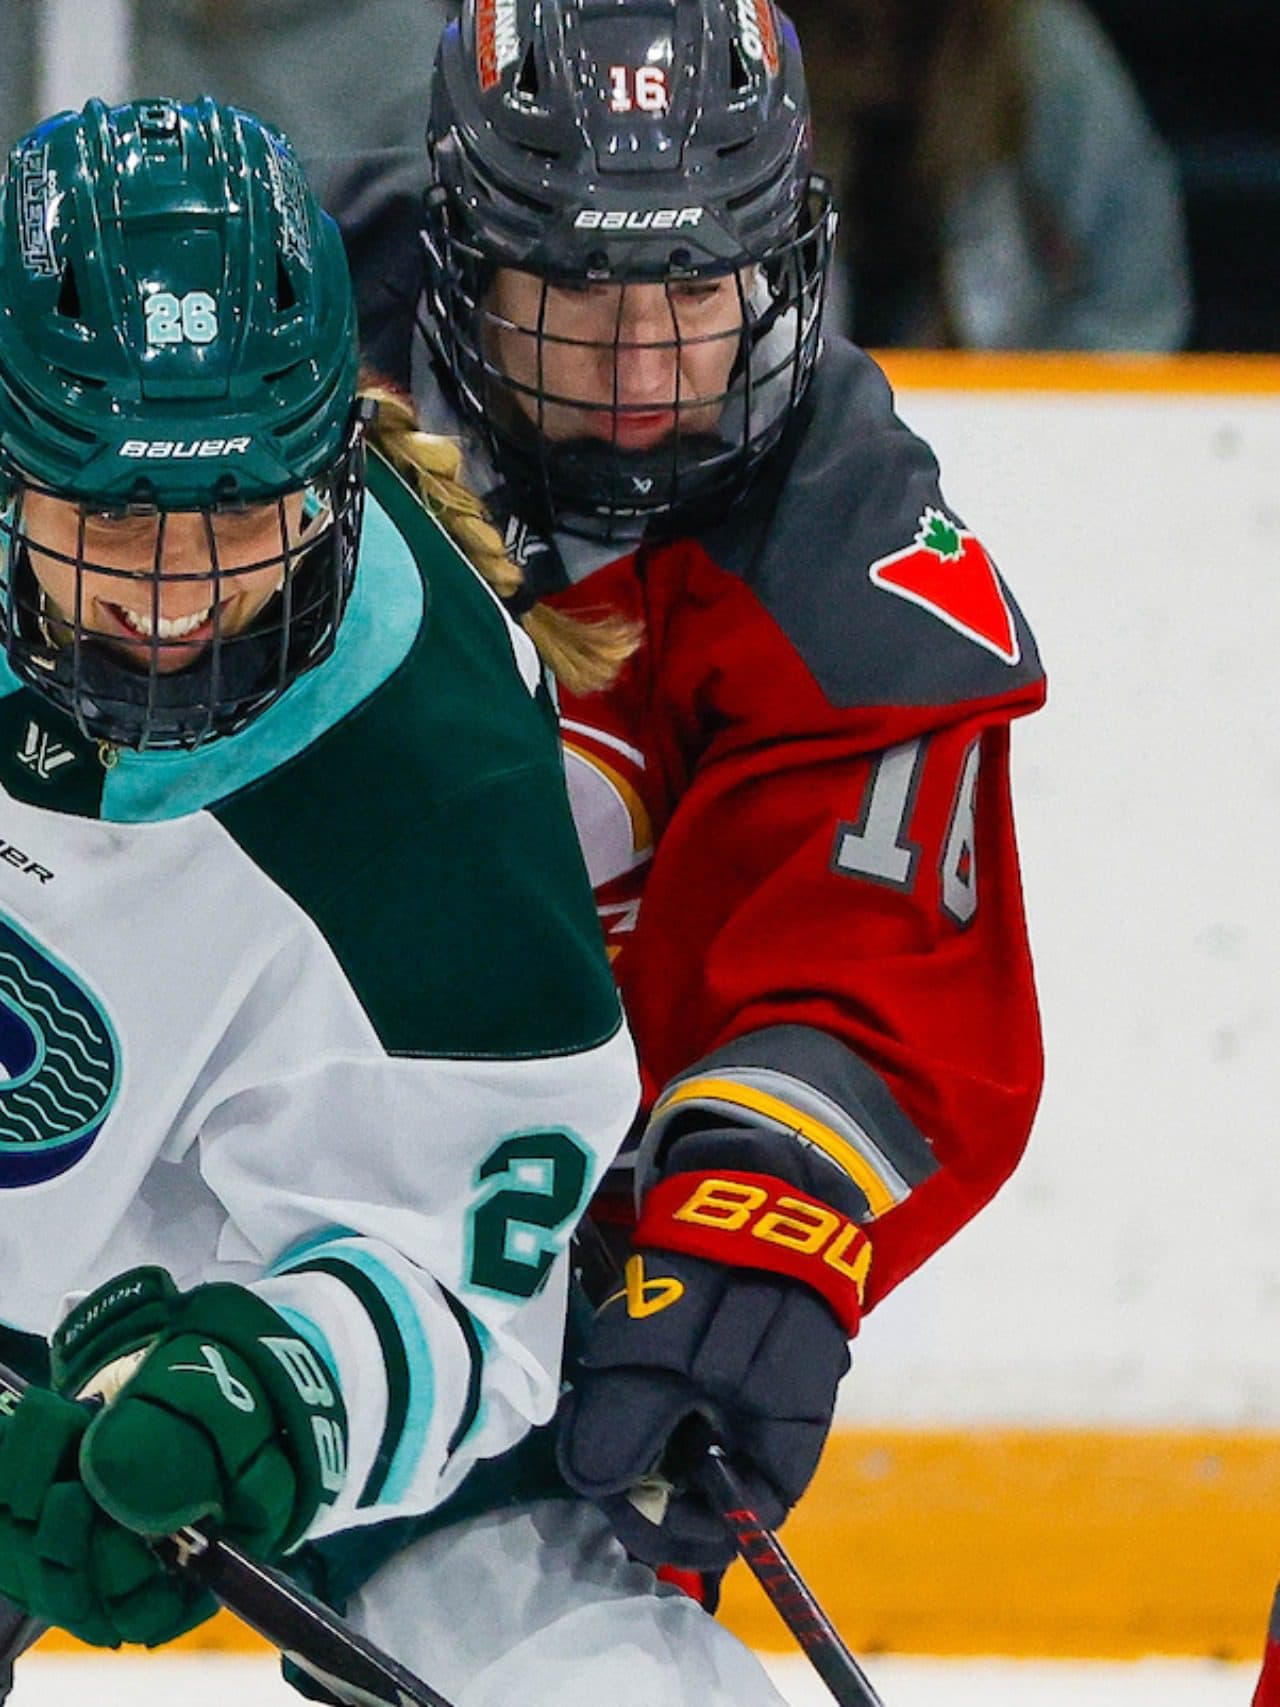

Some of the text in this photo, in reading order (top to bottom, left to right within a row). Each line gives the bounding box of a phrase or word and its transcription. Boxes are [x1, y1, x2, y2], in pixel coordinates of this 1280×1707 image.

[610, 65, 668, 111] 16
[574, 207, 703, 230] BAUER
[143, 291, 219, 344] 26
[119, 436, 252, 459] BAUER
[672, 1178, 873, 1306] BAU
